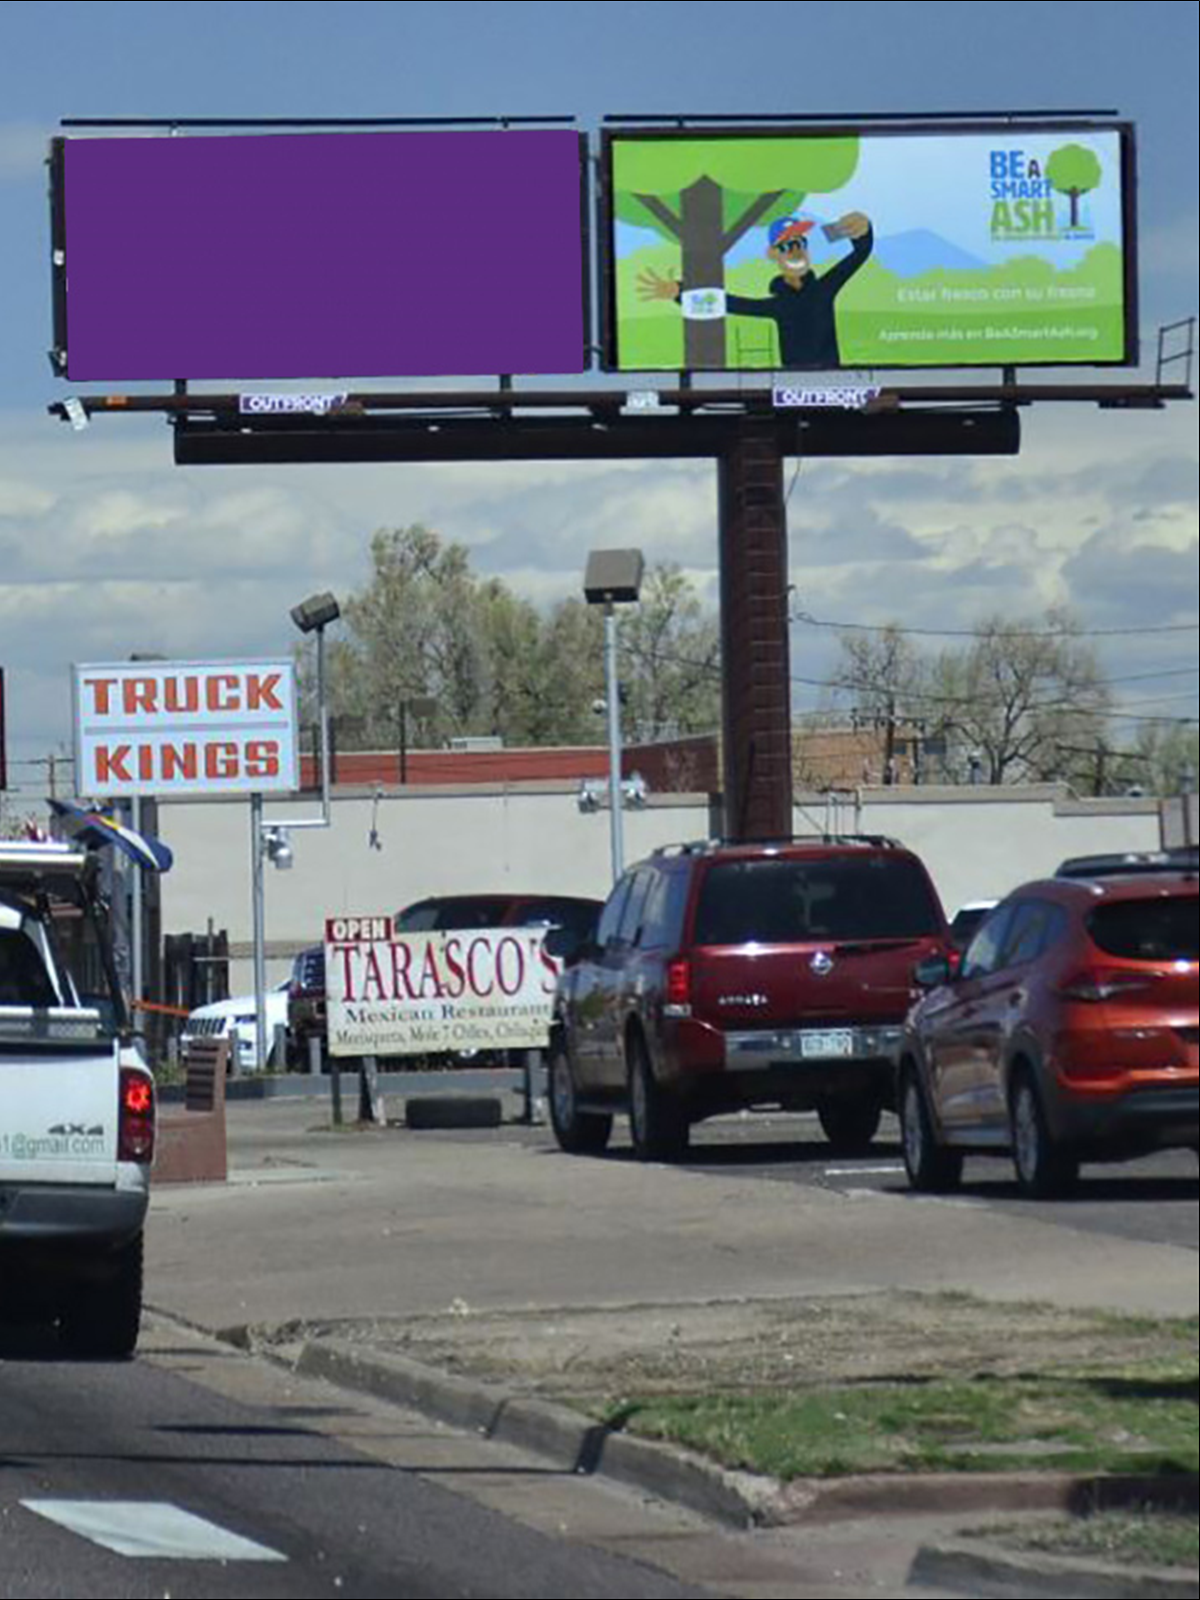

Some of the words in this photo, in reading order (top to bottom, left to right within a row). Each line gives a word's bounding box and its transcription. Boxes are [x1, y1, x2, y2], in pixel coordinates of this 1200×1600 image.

[990, 150, 1024, 179] BE
[1028, 159, 1041, 179] A
[990, 179, 1054, 199] SMART
[989, 200, 1054, 233] ASH
[84, 673, 283, 715] TRUCK
[95, 740, 280, 783] KINGS
[332, 920, 385, 940] OPEN
[333, 935, 559, 1003] TARASCO'S
[345, 1007, 433, 1023] Mexican
[441, 1003, 550, 1020] Restaurant
